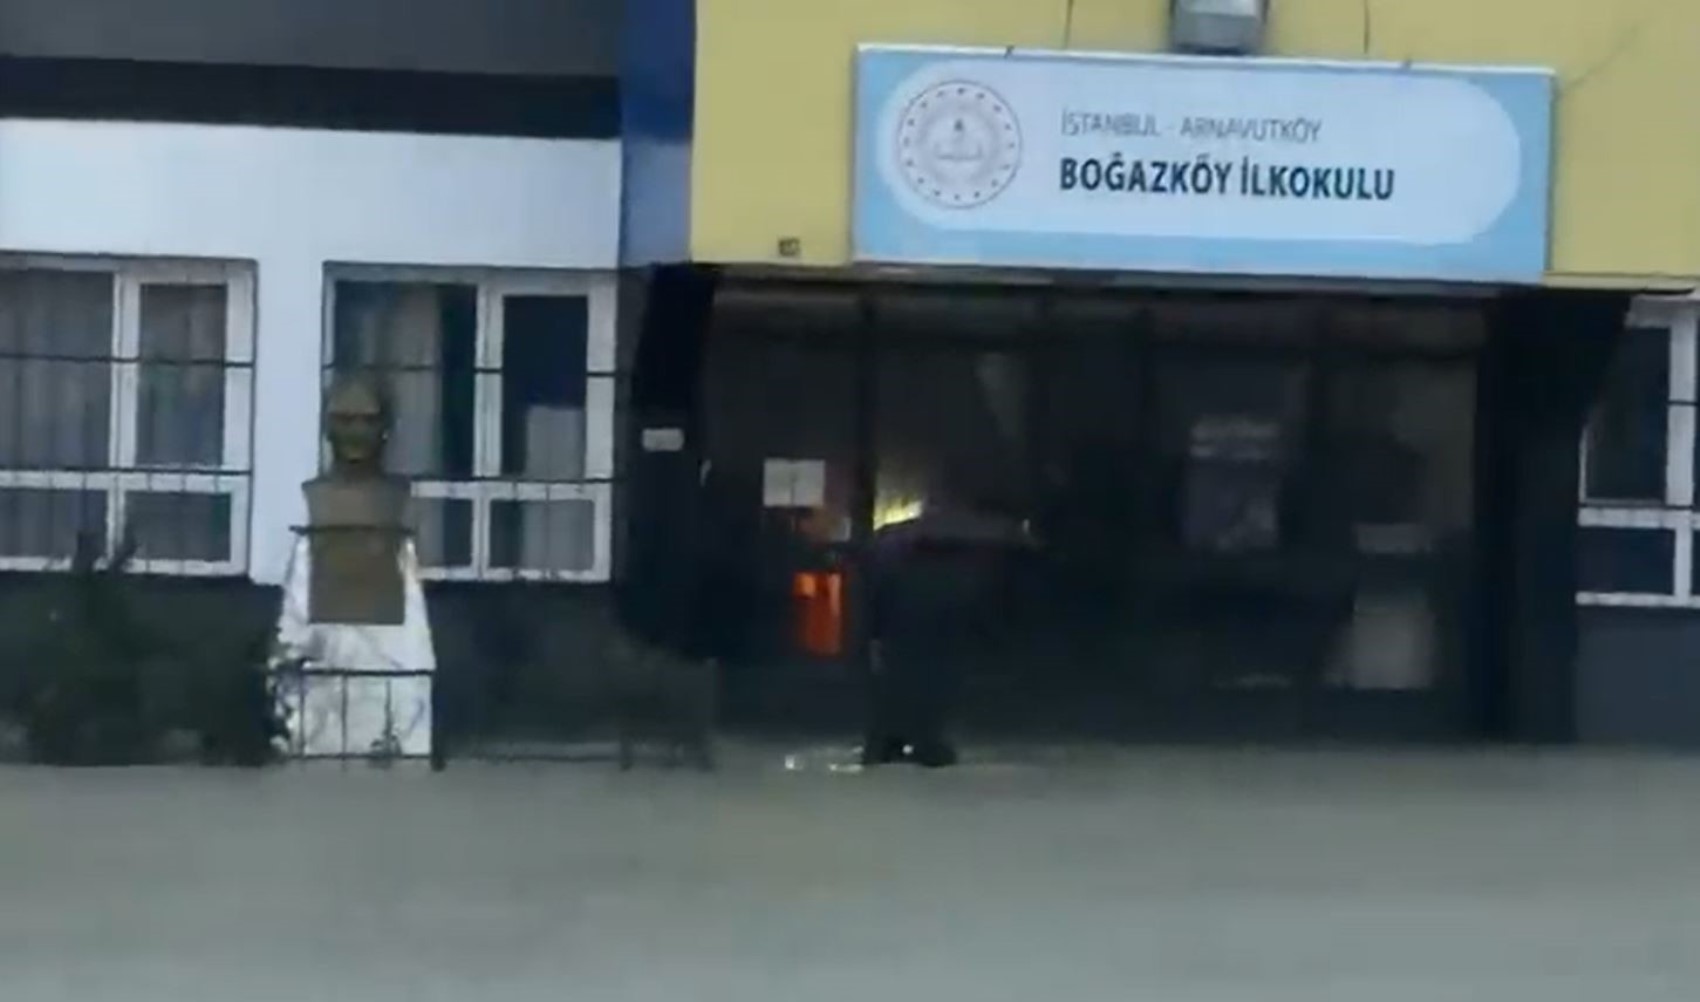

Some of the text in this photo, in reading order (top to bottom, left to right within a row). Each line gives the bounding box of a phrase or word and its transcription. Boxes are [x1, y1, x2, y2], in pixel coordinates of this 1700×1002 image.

[1061, 109, 1160, 137] İSTANBUL
[1179, 116, 1322, 144] ARNAVUTKÖY
[1060, 152, 1395, 200] BOĞAZKÖY İLKOKULU
